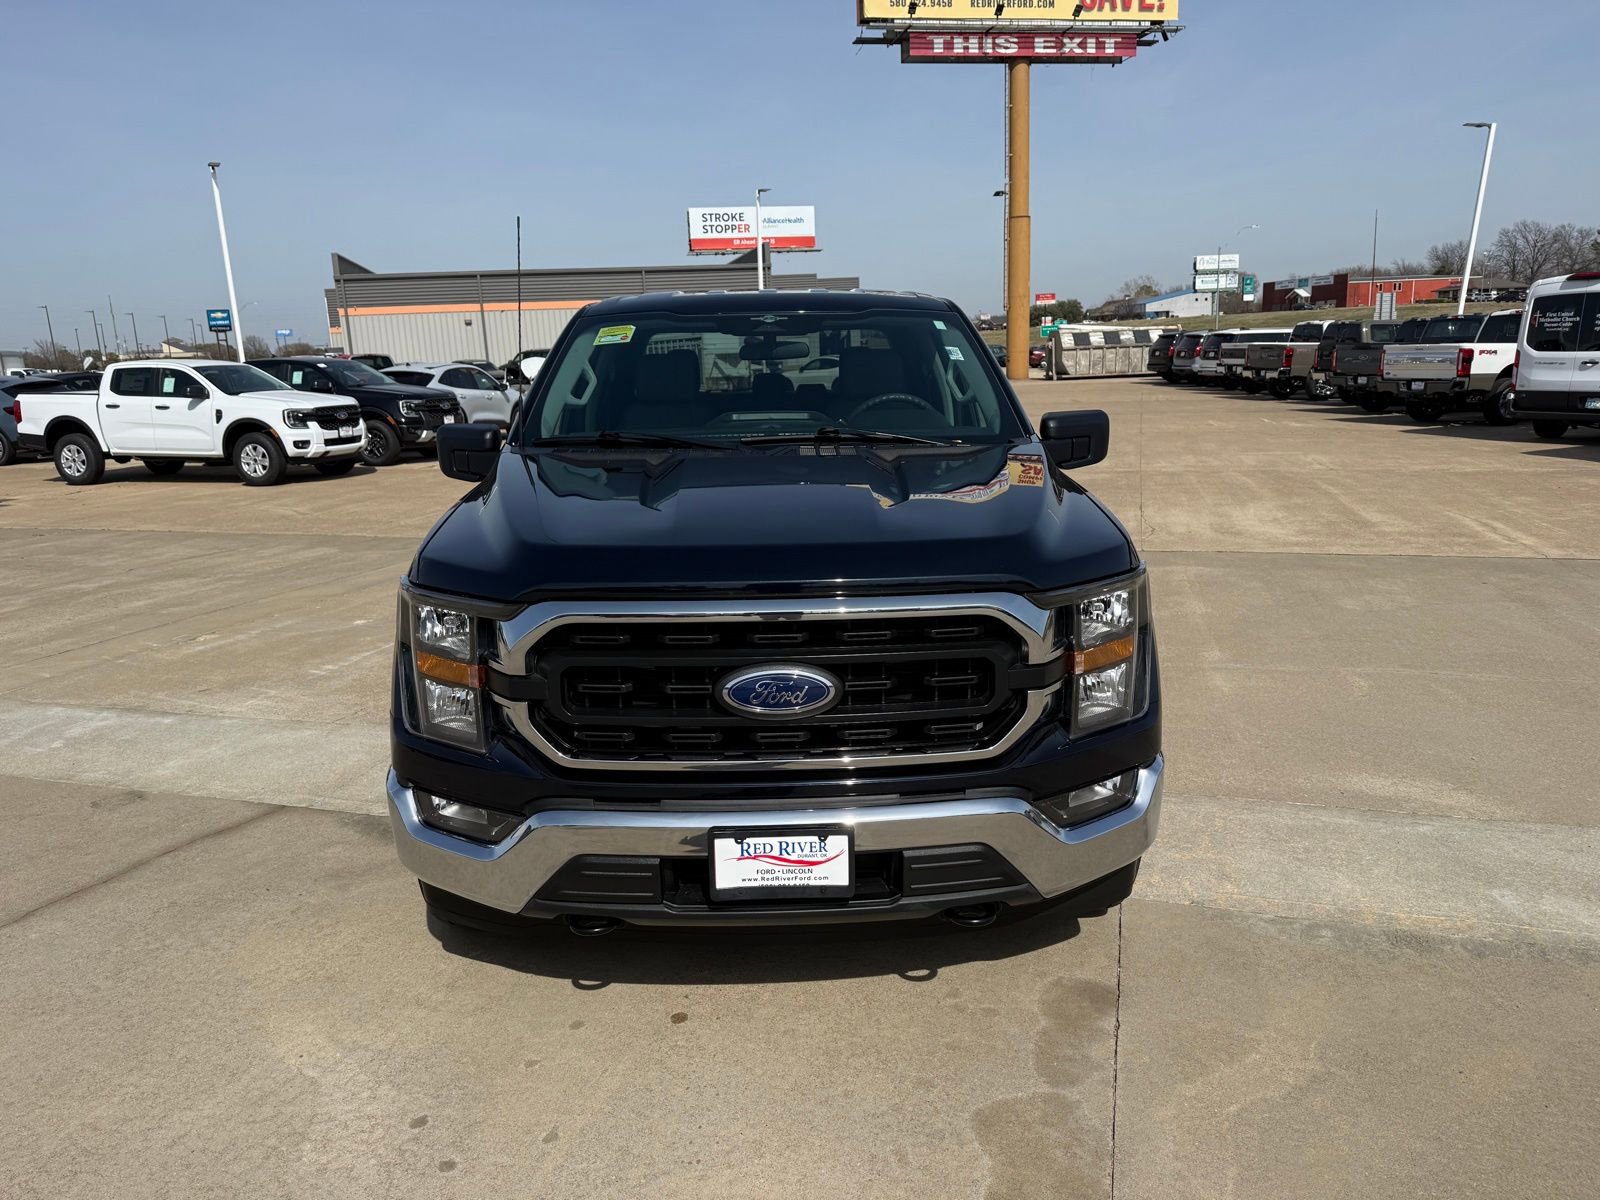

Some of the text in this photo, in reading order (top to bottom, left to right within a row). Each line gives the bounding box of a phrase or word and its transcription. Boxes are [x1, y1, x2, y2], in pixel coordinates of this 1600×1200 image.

[926, 36, 1122, 54] THIS EXIT
[701, 212, 745, 223] STROKE
[702, 223, 751, 234] STOPPER
[749, 680, 809, 704] Ford
[740, 840, 829, 857] RED RIVER
